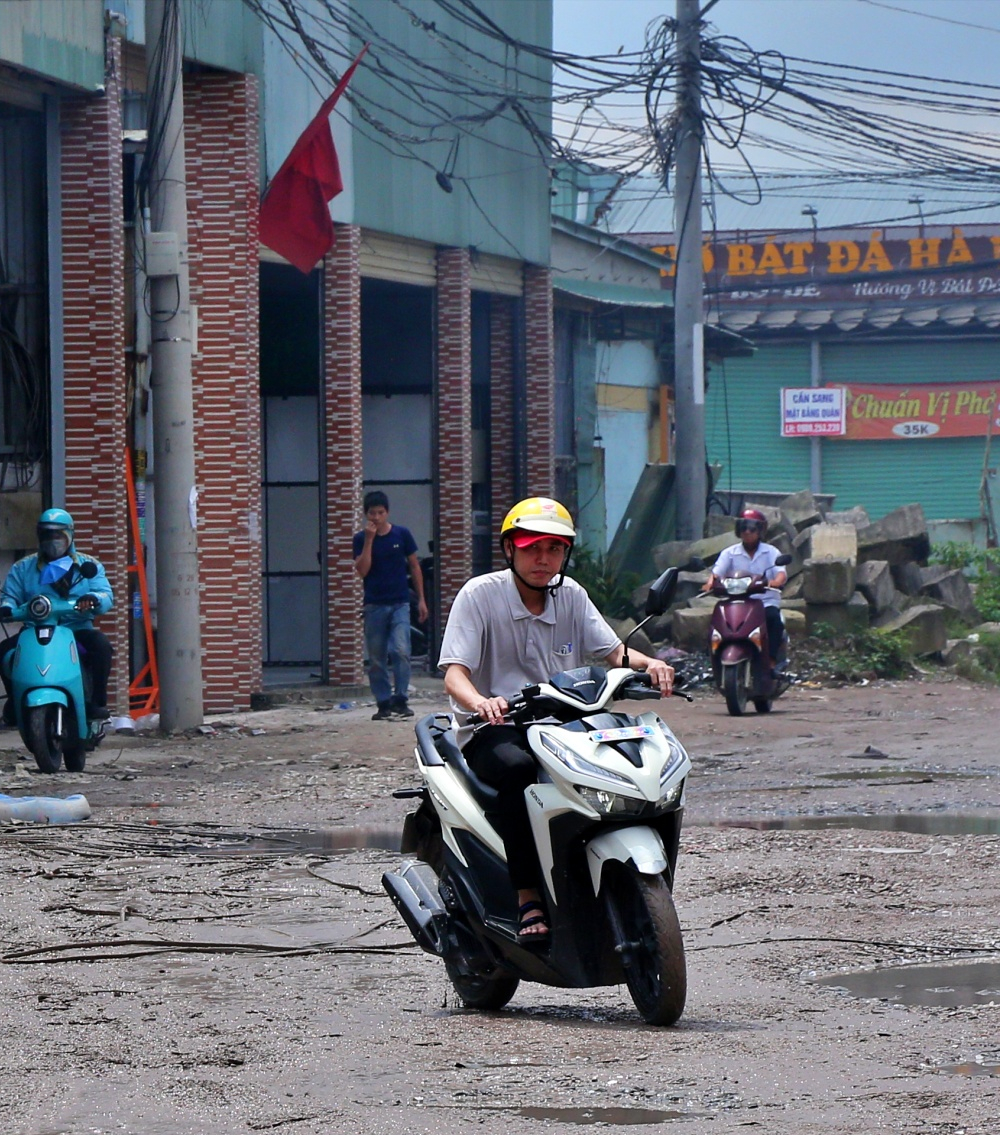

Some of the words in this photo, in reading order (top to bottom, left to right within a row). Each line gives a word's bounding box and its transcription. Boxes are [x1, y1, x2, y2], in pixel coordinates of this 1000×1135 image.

[727, 235, 813, 275] BÁT
[827, 230, 893, 273] ĐÁ
[917, 278, 938, 296] Vị
[926, 391, 950, 423] Vị
[903, 424, 929, 435] 35K
